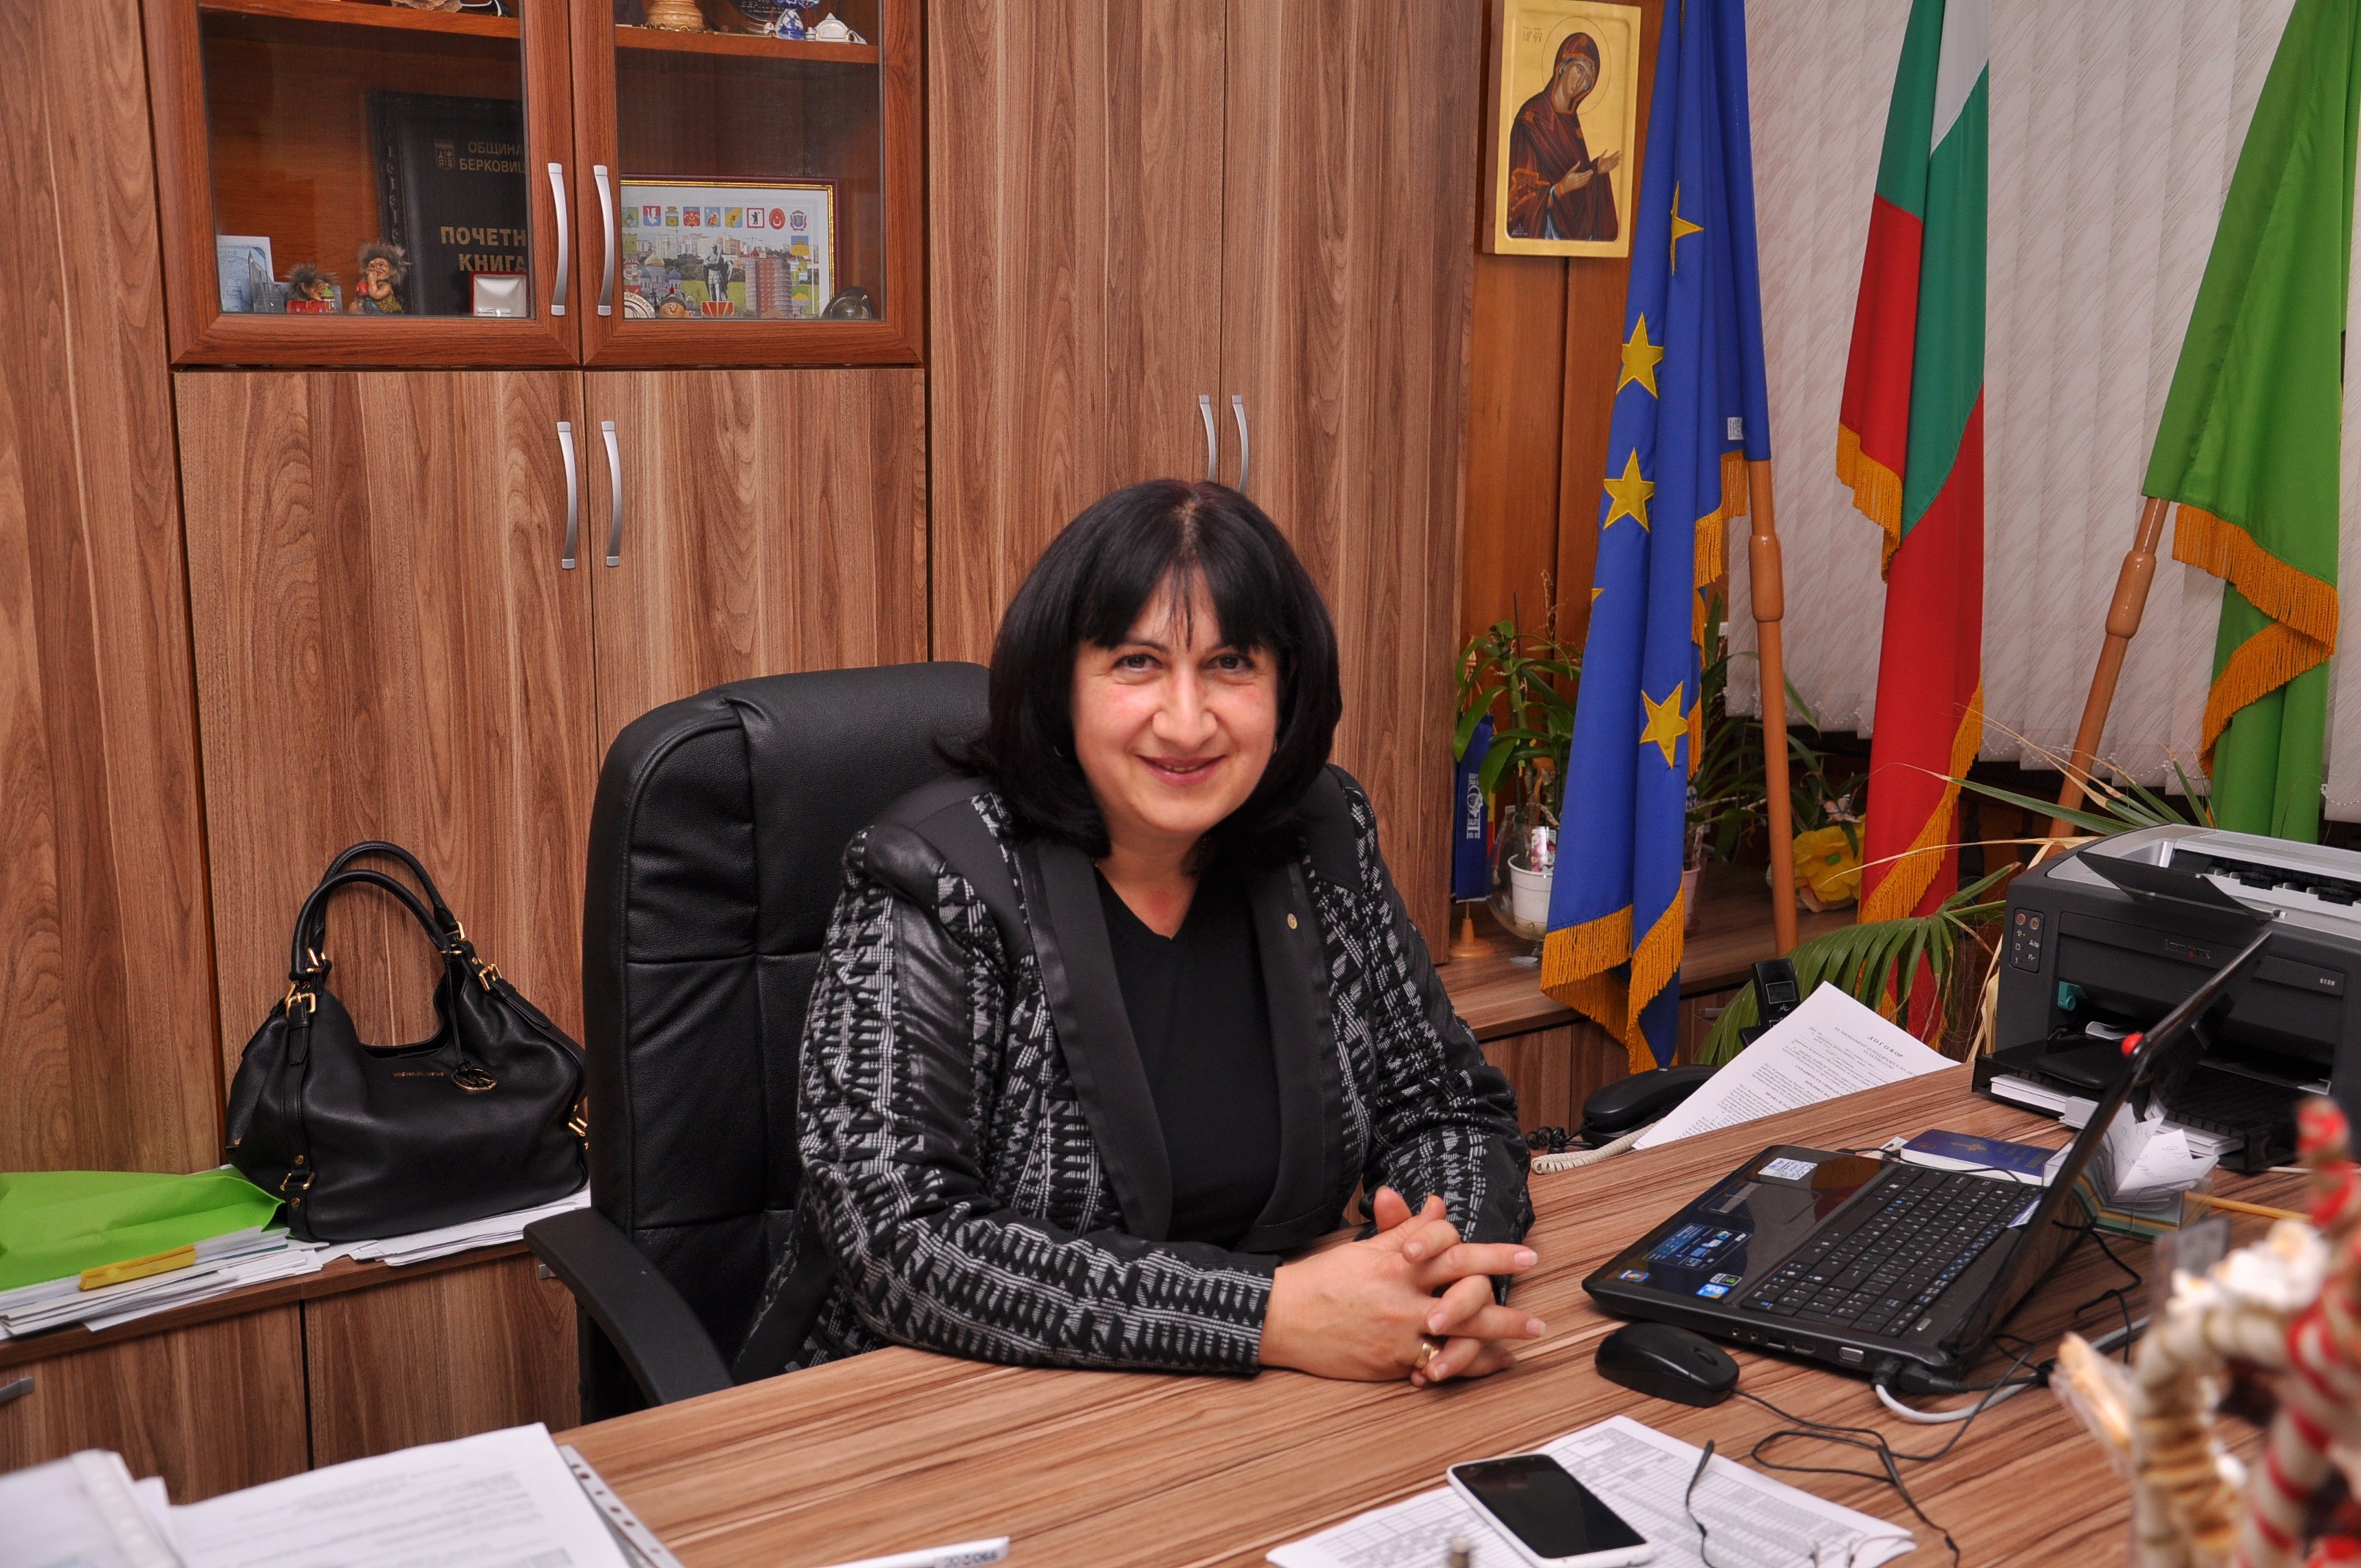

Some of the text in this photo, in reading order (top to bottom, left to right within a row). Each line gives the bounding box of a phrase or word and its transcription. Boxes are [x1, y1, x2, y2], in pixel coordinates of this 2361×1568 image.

[468, 140, 523, 156] ОБЩИНА
[440, 226, 527, 247] ПОЧЕТН
[458, 253, 527, 272] КНИГА
